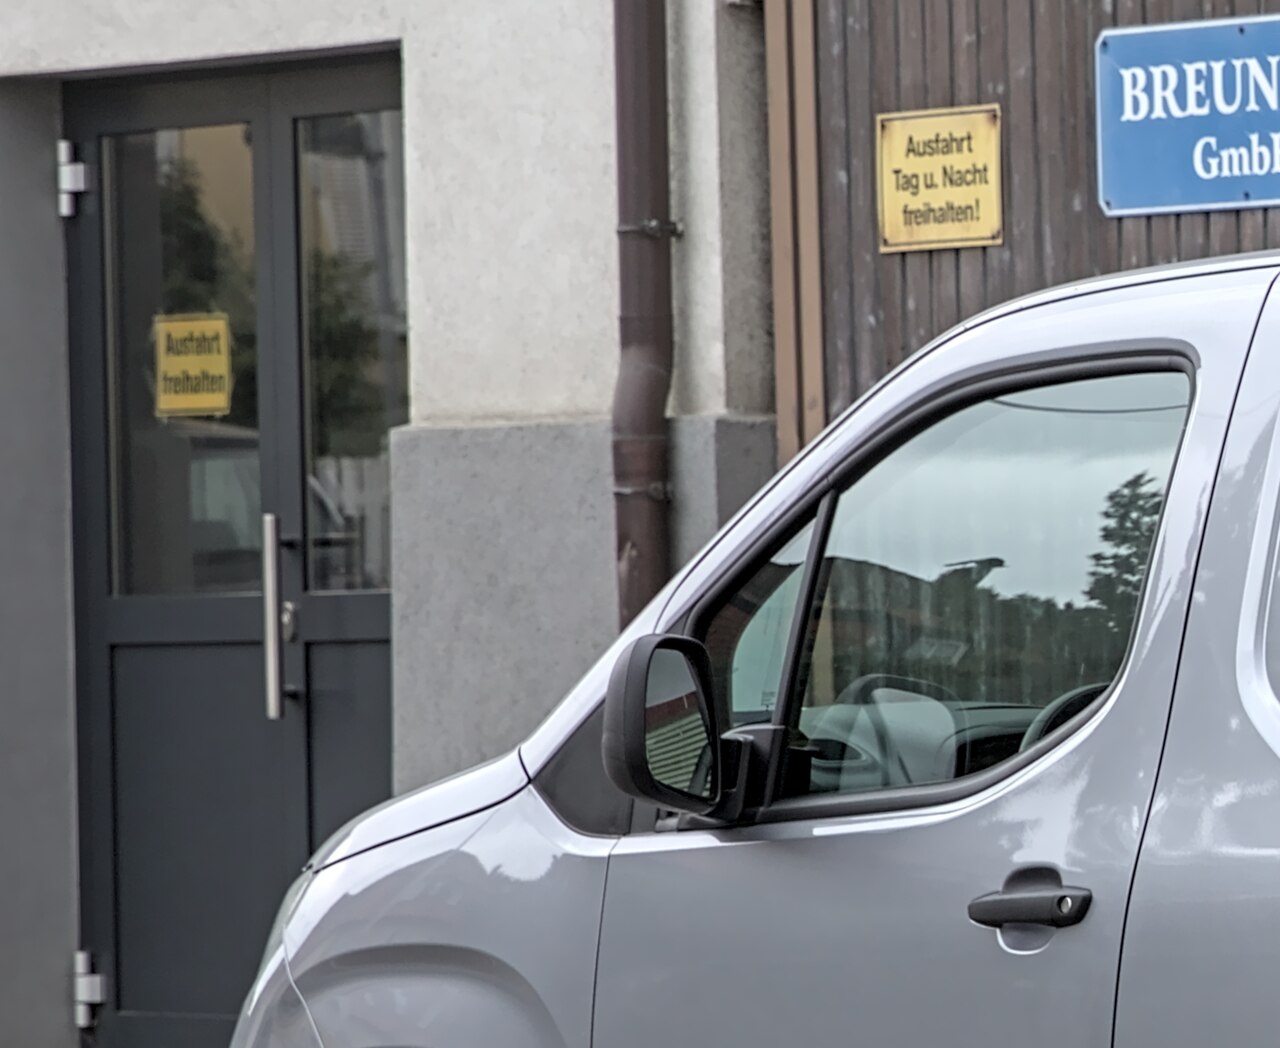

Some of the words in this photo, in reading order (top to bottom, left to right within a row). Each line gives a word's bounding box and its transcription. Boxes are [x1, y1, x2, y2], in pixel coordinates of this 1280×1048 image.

[905, 131, 973, 158] Ausfahrt
[892, 168, 919, 197] Tag
[924, 172, 938, 190] u.
[942, 163, 989, 188] Nacht
[902, 198, 980, 227] freihalten!
[166, 332, 220, 356] Ausfahrt
[163, 369, 226, 395] freihalten
